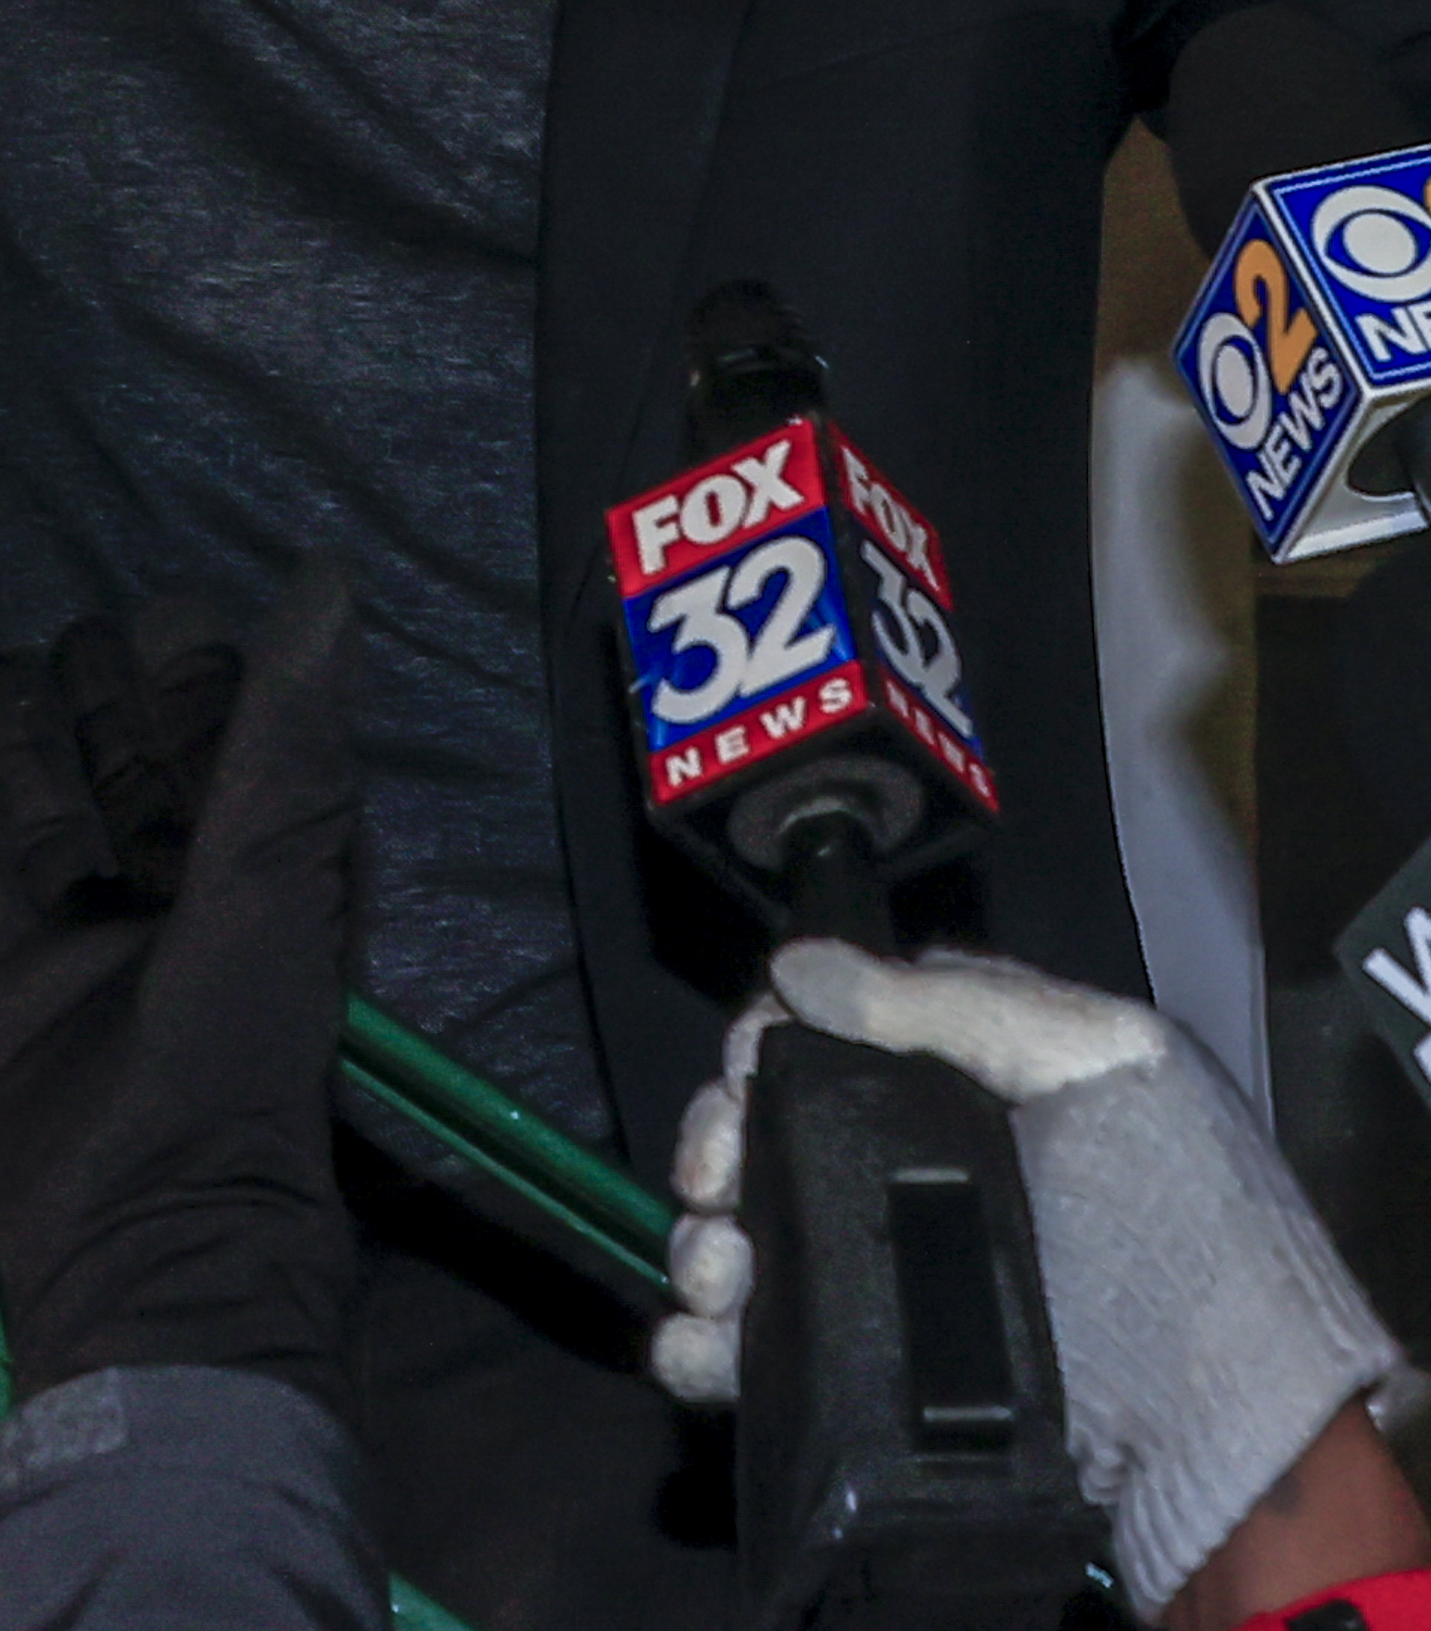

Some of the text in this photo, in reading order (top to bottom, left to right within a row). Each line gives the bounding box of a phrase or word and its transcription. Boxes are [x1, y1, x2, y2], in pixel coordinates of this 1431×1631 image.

[1235, 239, 1317, 394] 2
[632, 440, 804, 574] FOX
[1246, 347, 1344, 520] NEWS
[842, 446, 940, 591] FOX
[647, 536, 836, 724] 32
[860, 541, 973, 738] 32
[665, 678, 852, 786] NEWS
